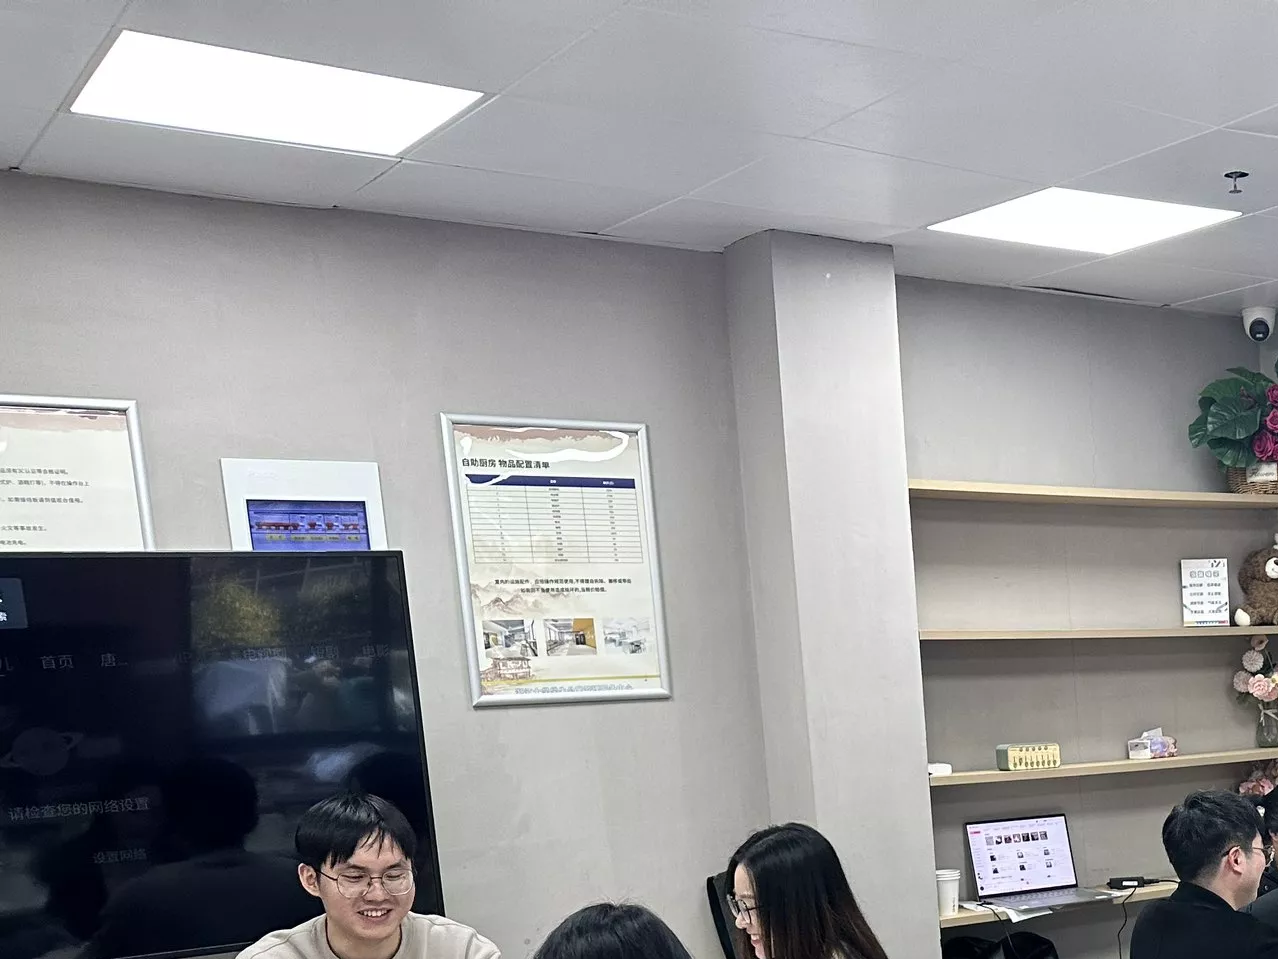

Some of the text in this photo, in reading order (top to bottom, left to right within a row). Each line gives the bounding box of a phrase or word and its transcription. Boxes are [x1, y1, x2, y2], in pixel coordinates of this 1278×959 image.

[462, 458, 550, 469] 自助厨房 物品配置清单
[40, 654, 74, 669] 首页
[8, 796, 151, 821] 请检查您的网络设置
